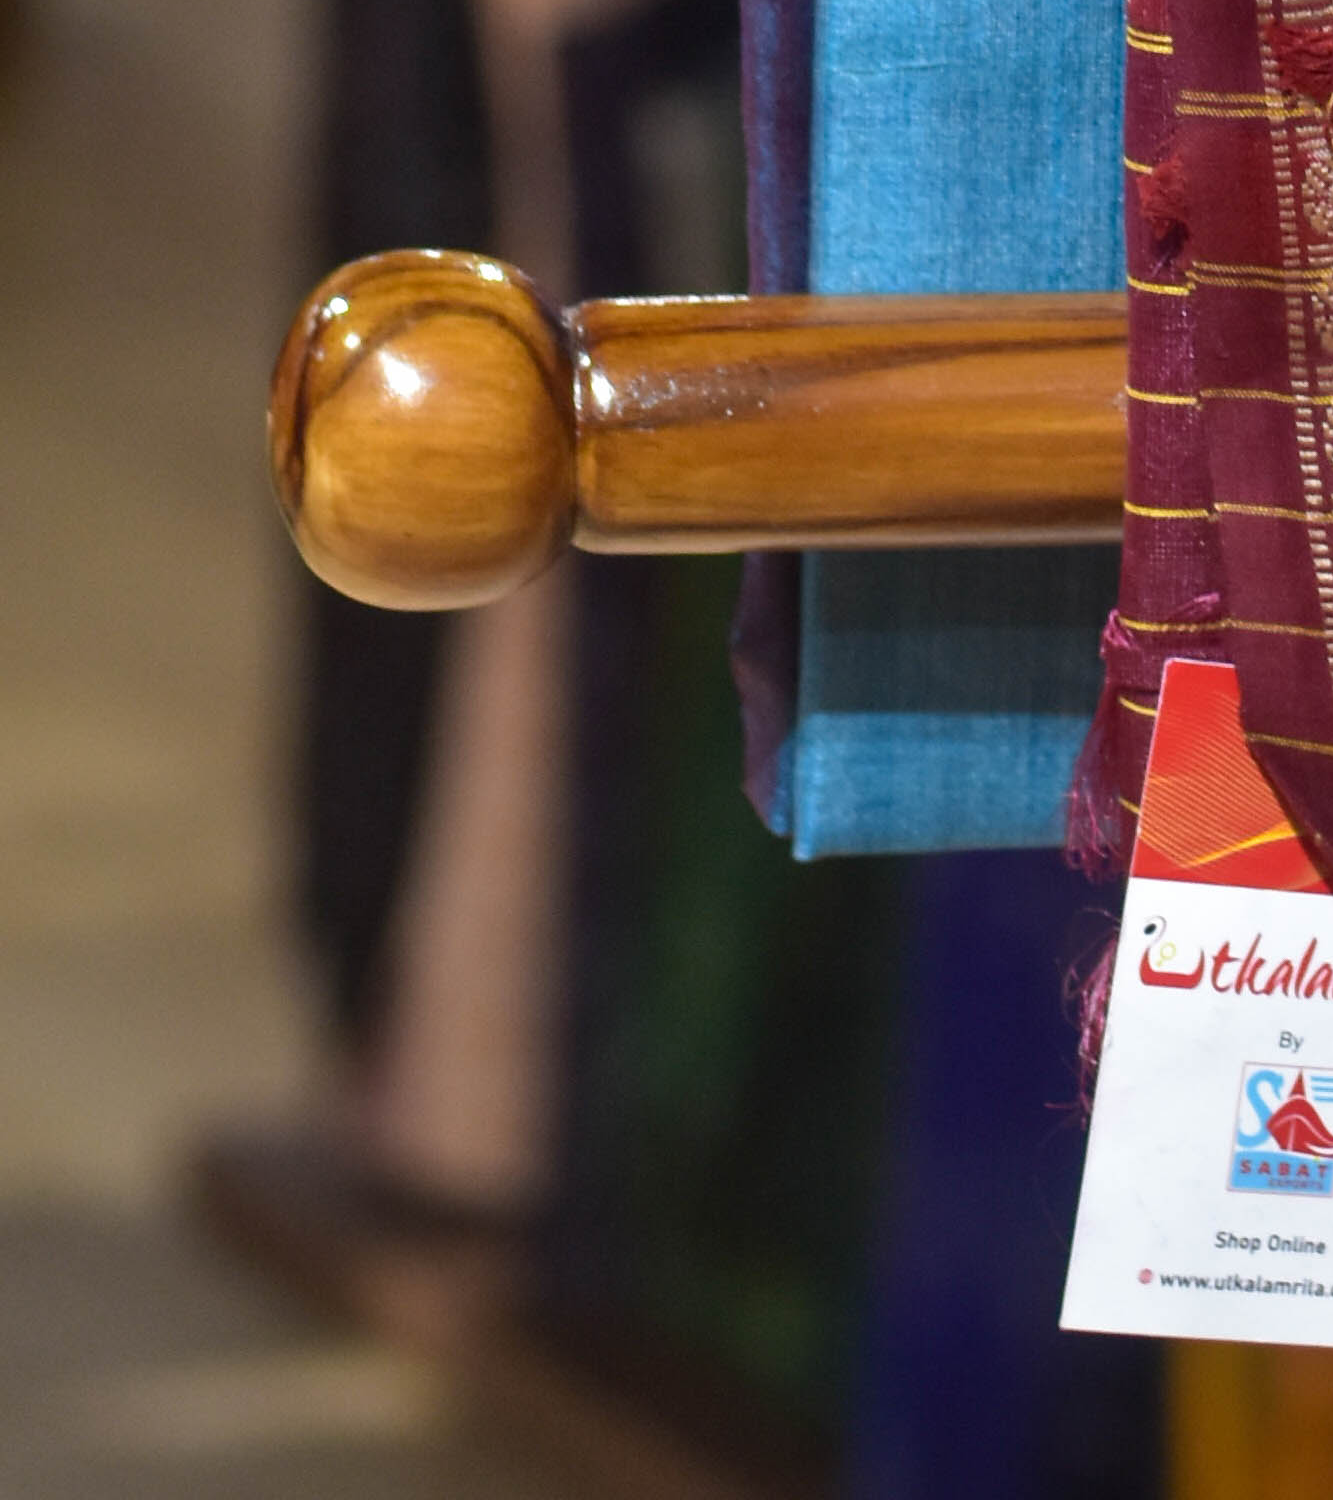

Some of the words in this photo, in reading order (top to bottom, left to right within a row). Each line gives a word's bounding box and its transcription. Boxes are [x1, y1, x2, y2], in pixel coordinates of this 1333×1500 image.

[1278, 1031, 1303, 1052] By
[1239, 1159, 1329, 1178] SABAT
[1214, 1231, 1261, 1254] Shop
[1267, 1234, 1326, 1255] Online
